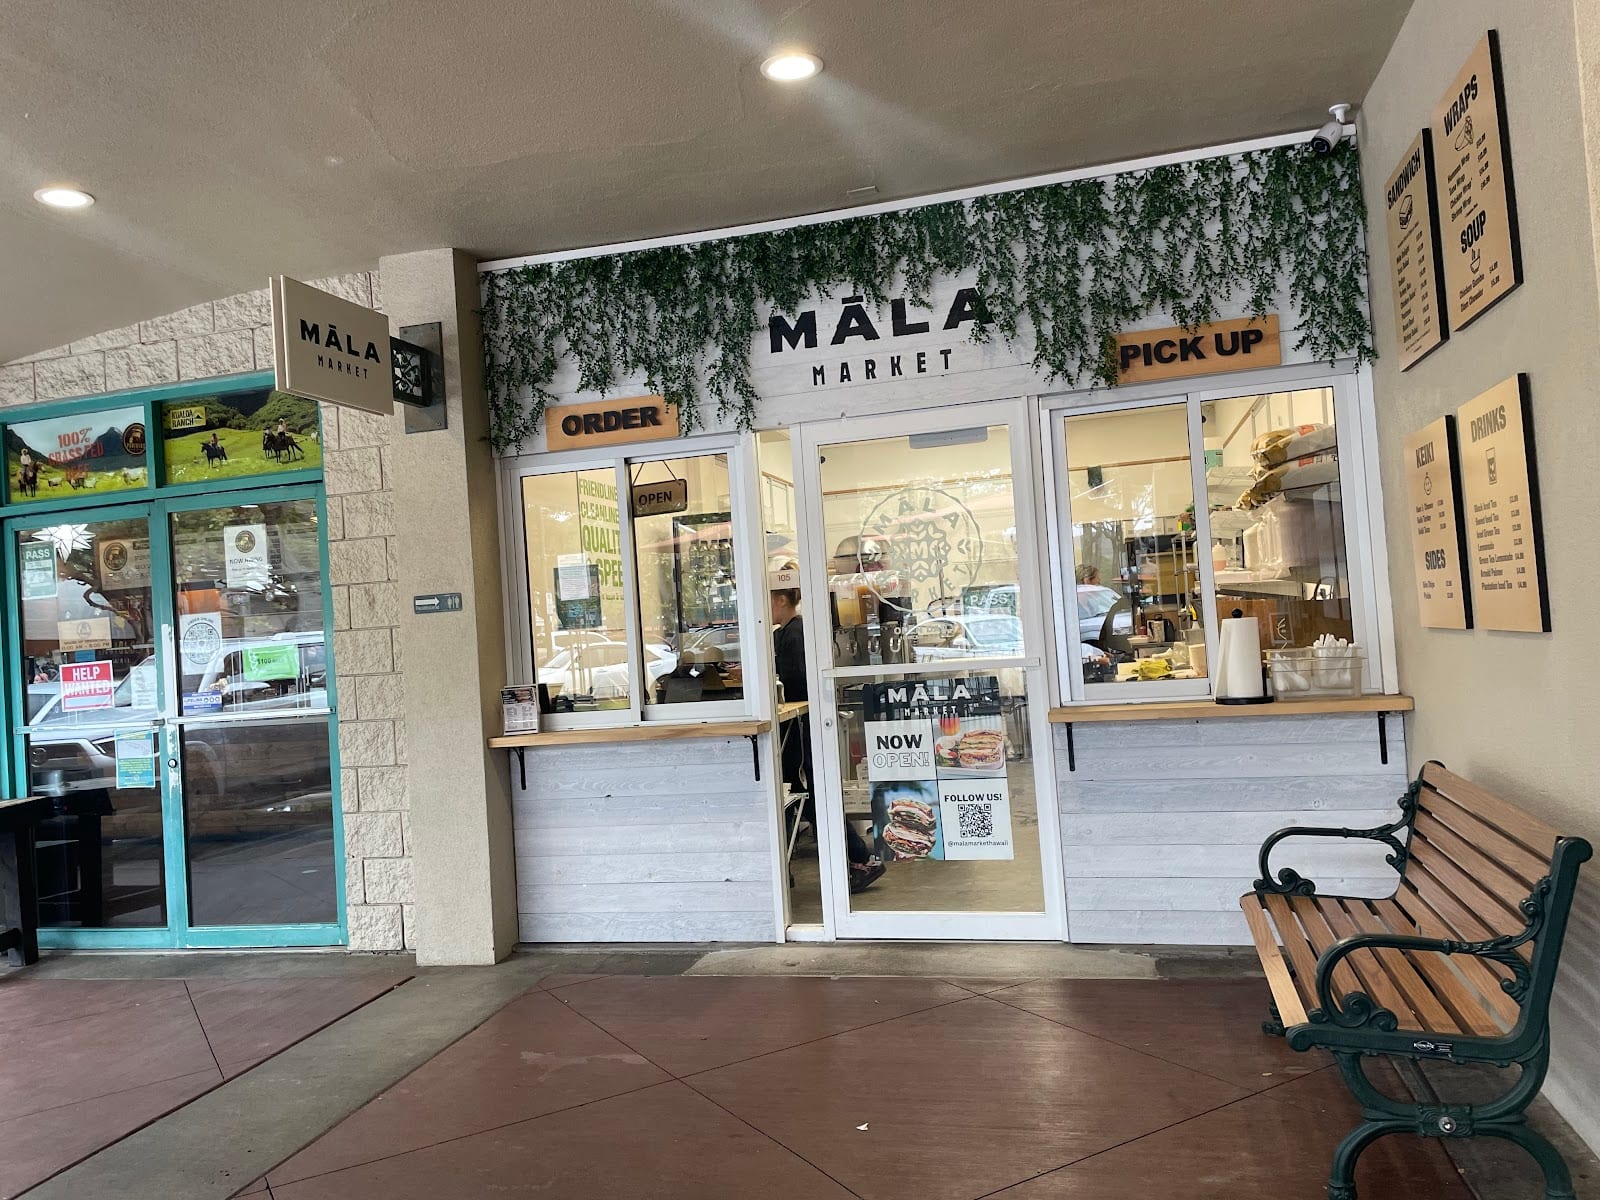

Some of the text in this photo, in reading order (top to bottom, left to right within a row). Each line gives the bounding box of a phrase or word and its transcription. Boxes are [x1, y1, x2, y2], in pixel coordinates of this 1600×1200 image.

[1444, 74, 1478, 137] WRAPS
[1387, 148, 1422, 210] SANDWICH
[1460, 210, 1487, 254] SOUP
[769, 288, 996, 353] MĀLA
[299, 318, 381, 364] MĀLA
[1120, 329, 1263, 370] PICK UP
[317, 354, 368, 380] MARKET
[812, 349, 952, 386] MARKET
[172, 417, 194, 428] RANCH
[561, 406, 662, 436] ORDER
[1470, 405, 1507, 443] DRINKS
[58, 427, 93, 448] 100%
[1416, 441, 1435, 468] KEIKI
[638, 490, 673, 506] OPEN
[25, 548, 50, 560] PASS
[1425, 549, 1446, 570] SIDES
[970, 592, 1009, 606] PASS
[72, 666, 100, 680] HELP
[63, 681, 110, 697] WANTED
[888, 684, 971, 704] MĀLA
[904, 706, 956, 717] MARKET
[876, 734, 922, 750] NOW
[873, 752, 930, 768] OPEN!
[944, 793, 1002, 802] FOLLOW US!
[948, 840, 1008, 848] @malamarkethawaii
